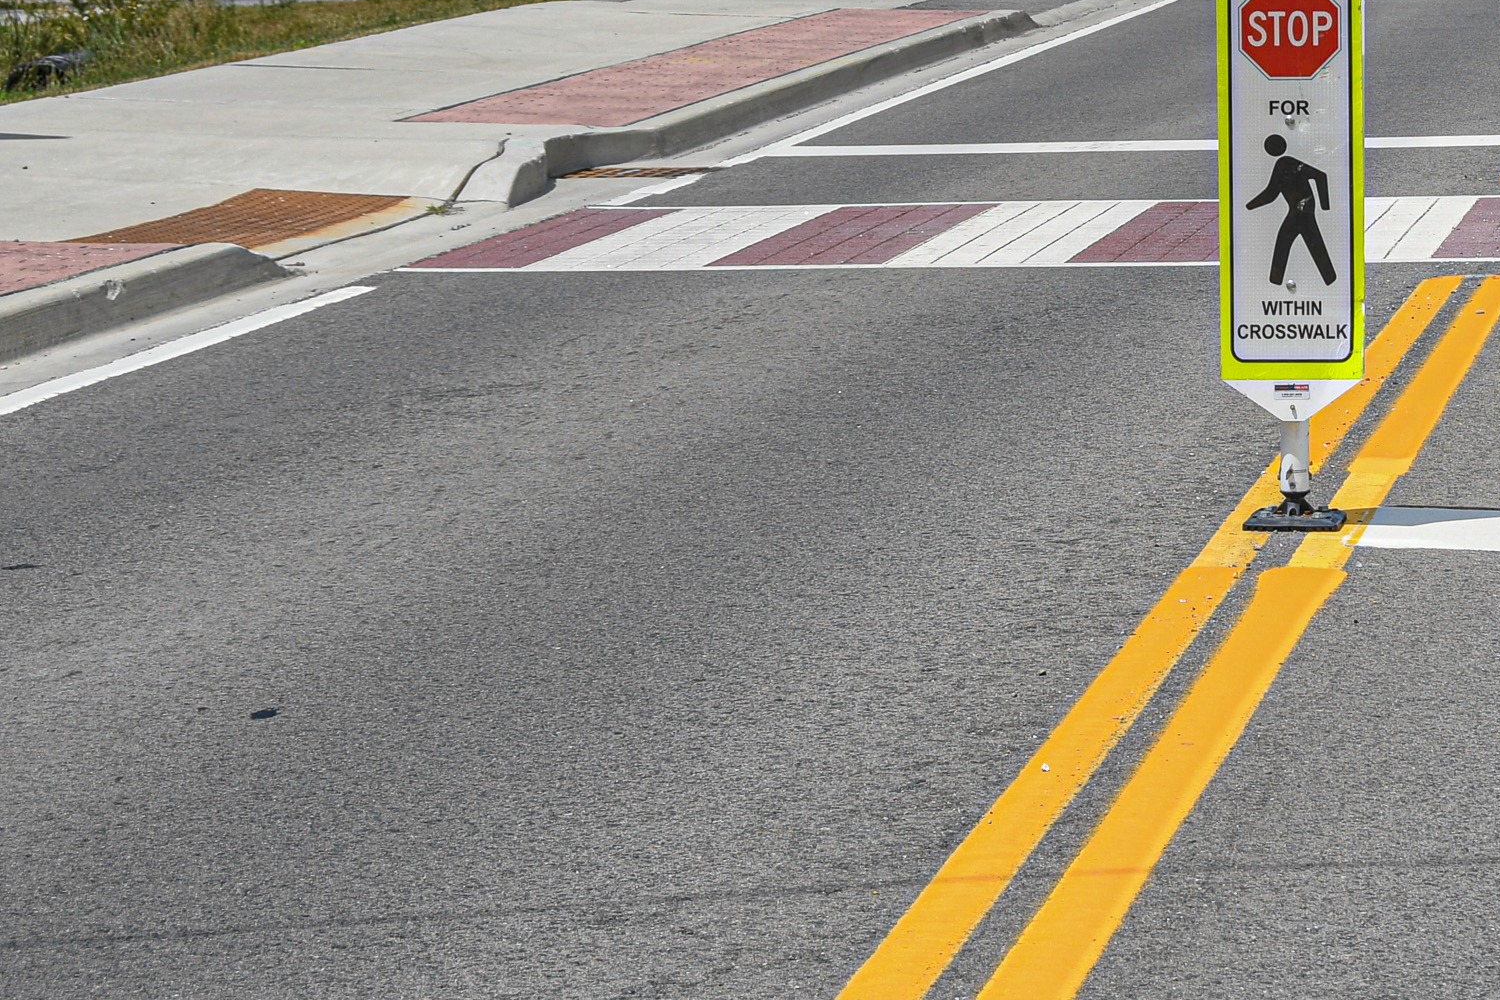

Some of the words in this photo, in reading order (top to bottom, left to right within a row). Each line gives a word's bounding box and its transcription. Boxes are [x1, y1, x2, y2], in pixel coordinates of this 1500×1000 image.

[1247, 10, 1333, 47] STOP
[1268, 100, 1310, 116] FOR
[1261, 300, 1322, 316] WITHIN
[1237, 323, 1348, 340] CROSSWALK
